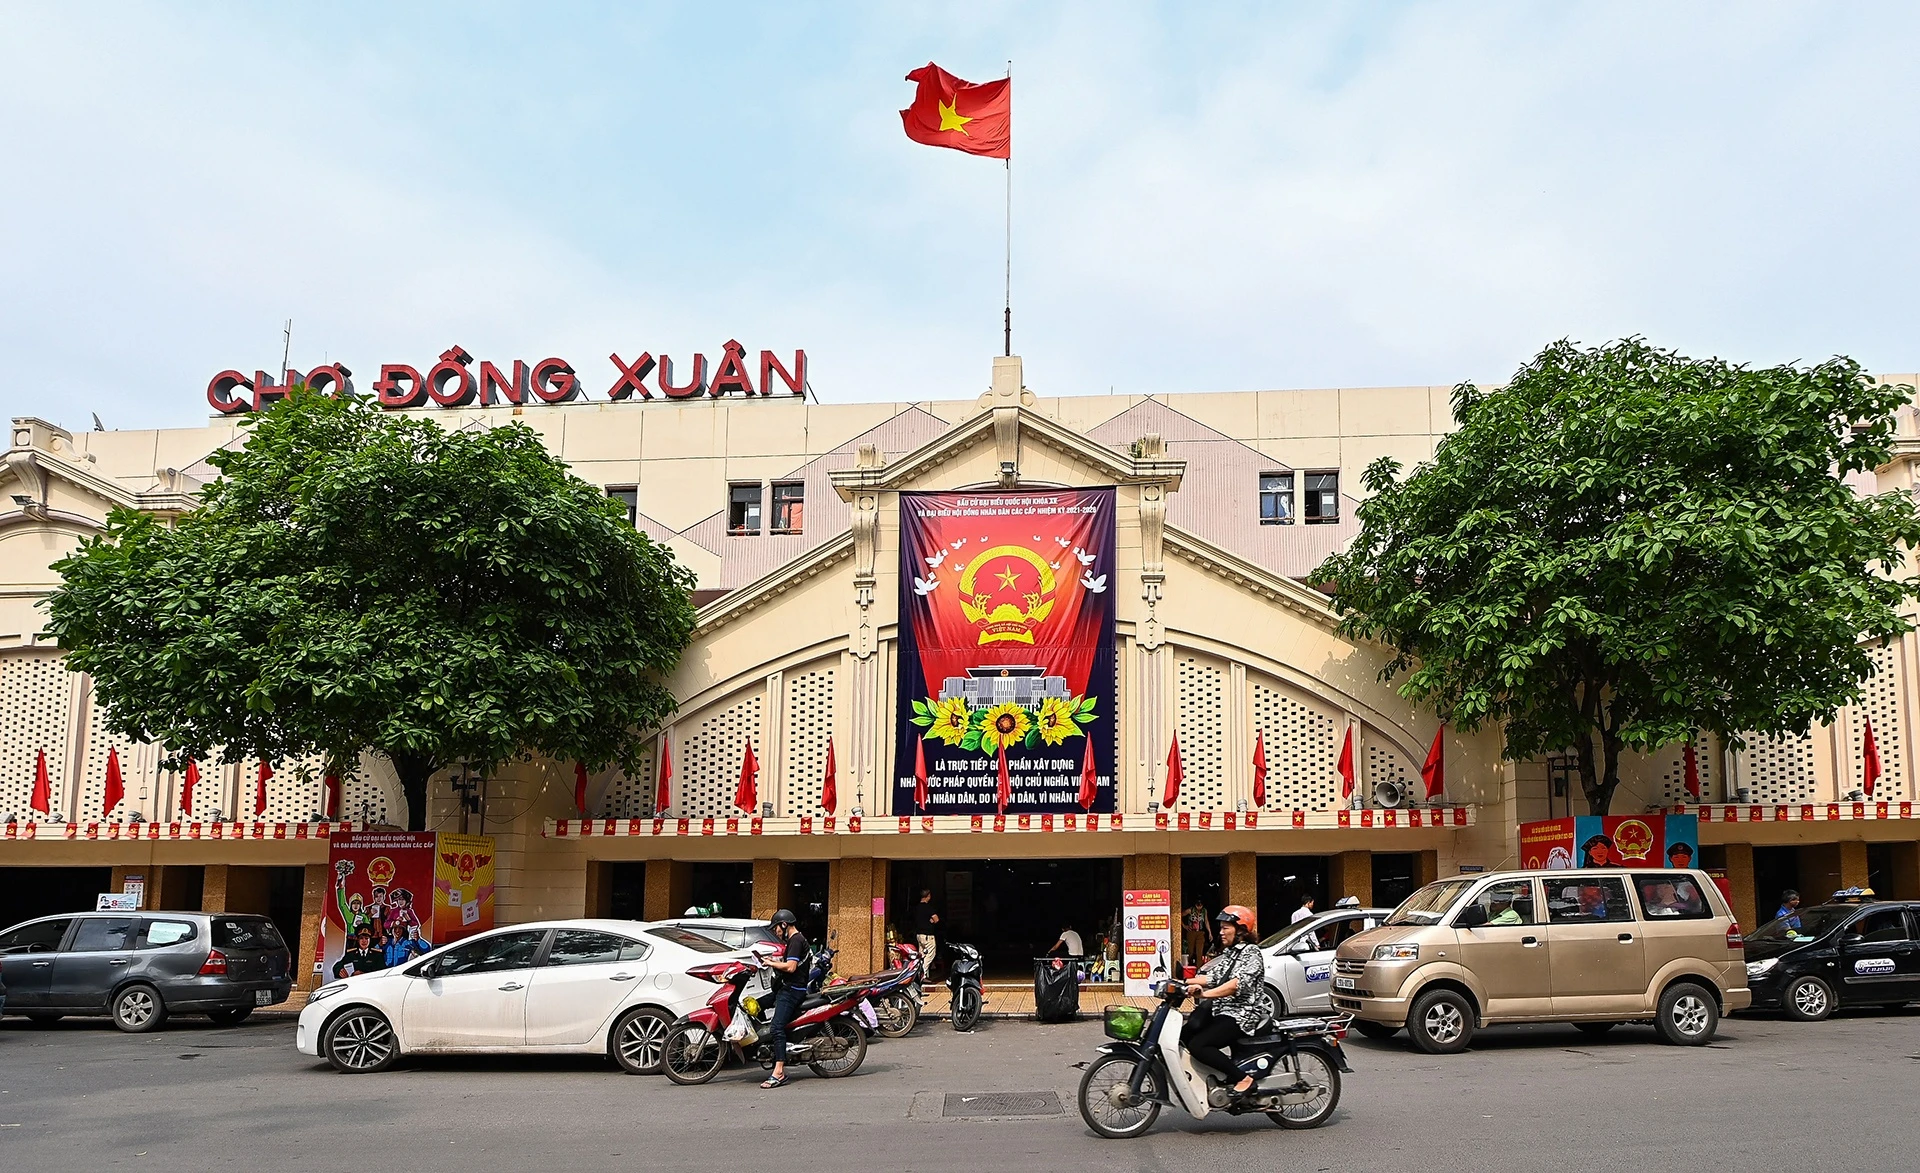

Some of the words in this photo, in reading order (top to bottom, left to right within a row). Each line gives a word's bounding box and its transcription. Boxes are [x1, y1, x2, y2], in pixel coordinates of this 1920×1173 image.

[373, 344, 581, 408] ĐỒNG
[607, 339, 806, 399] XUÂN
[980, 498, 990, 507] ĐẠI
[1004, 496, 1020, 506] QUỐC
[1021, 497, 1032, 506] HỘI
[938, 508, 951, 516] BIỂU
[952, 508, 962, 517] HỘI
[963, 508, 980, 516] ĐỒNG
[980, 508, 996, 516] NHÂN
[1011, 506, 1024, 515] CÁC
[1024, 506, 1036, 514] CẤP
[1037, 506, 1056, 515] NHIỆM
[935, 758, 946, 770] LÀ
[947, 759, 968, 772] TRỰC
[970, 756, 988, 770] TIẾP
[1033, 757, 1050, 770] XÂY
[1052, 758, 1074, 772] DỰNG
[900, 774, 916, 788] NHÀ
[926, 774, 942, 788] ƯỚC
[943, 774, 966, 788] PHÁP
[1009, 774, 1024, 788] HỘI
[1025, 772, 1041, 787] CHỦ
[1044, 774, 1069, 787] NGHĨA
[1095, 776, 1110, 787] AM
[932, 792, 956, 804] NHÂN
[958, 791, 977, 805] DÂN,
[980, 793, 993, 804] DO
[1018, 790, 1037, 804] DÂN,
[1039, 790, 1048, 804] VÌ
[1049, 790, 1072, 804] NHÂN
